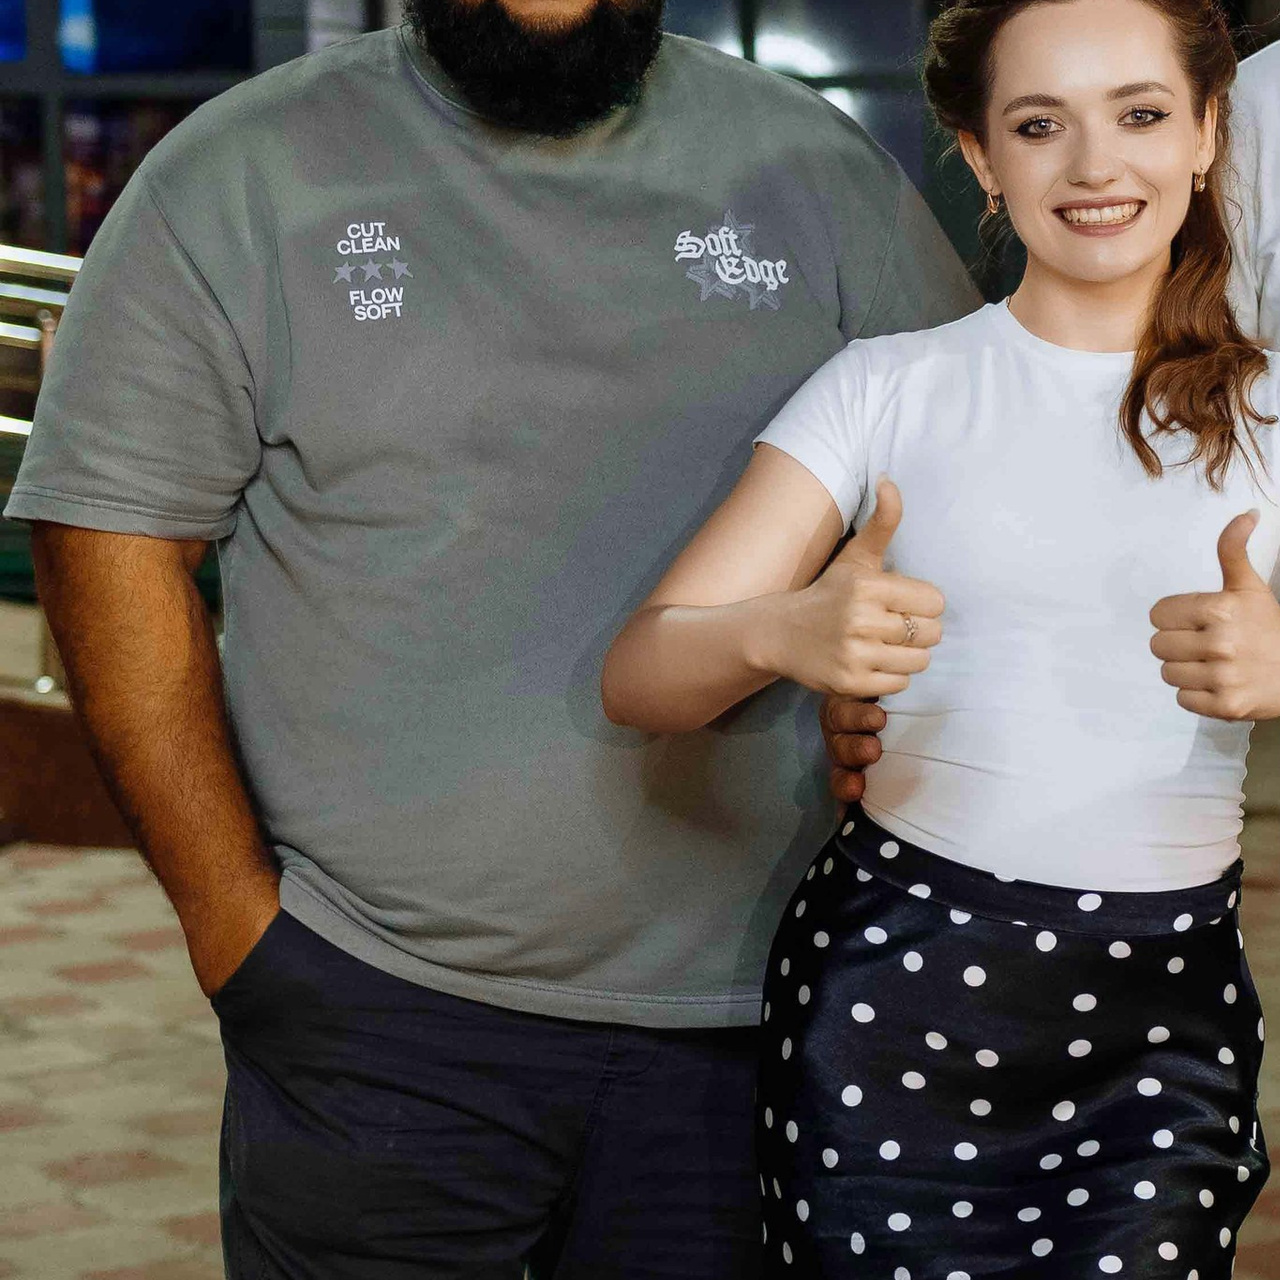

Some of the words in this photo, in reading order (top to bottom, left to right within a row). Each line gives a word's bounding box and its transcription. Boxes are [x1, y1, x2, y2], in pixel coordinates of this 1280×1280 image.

[346, 222, 386, 239] CUT
[336, 236, 401, 255] CLEAN
[674, 226, 743, 262] Soft
[715, 255, 790, 291] Edge
[349, 286, 404, 306] FLOW
[354, 302, 403, 321] SOFT
